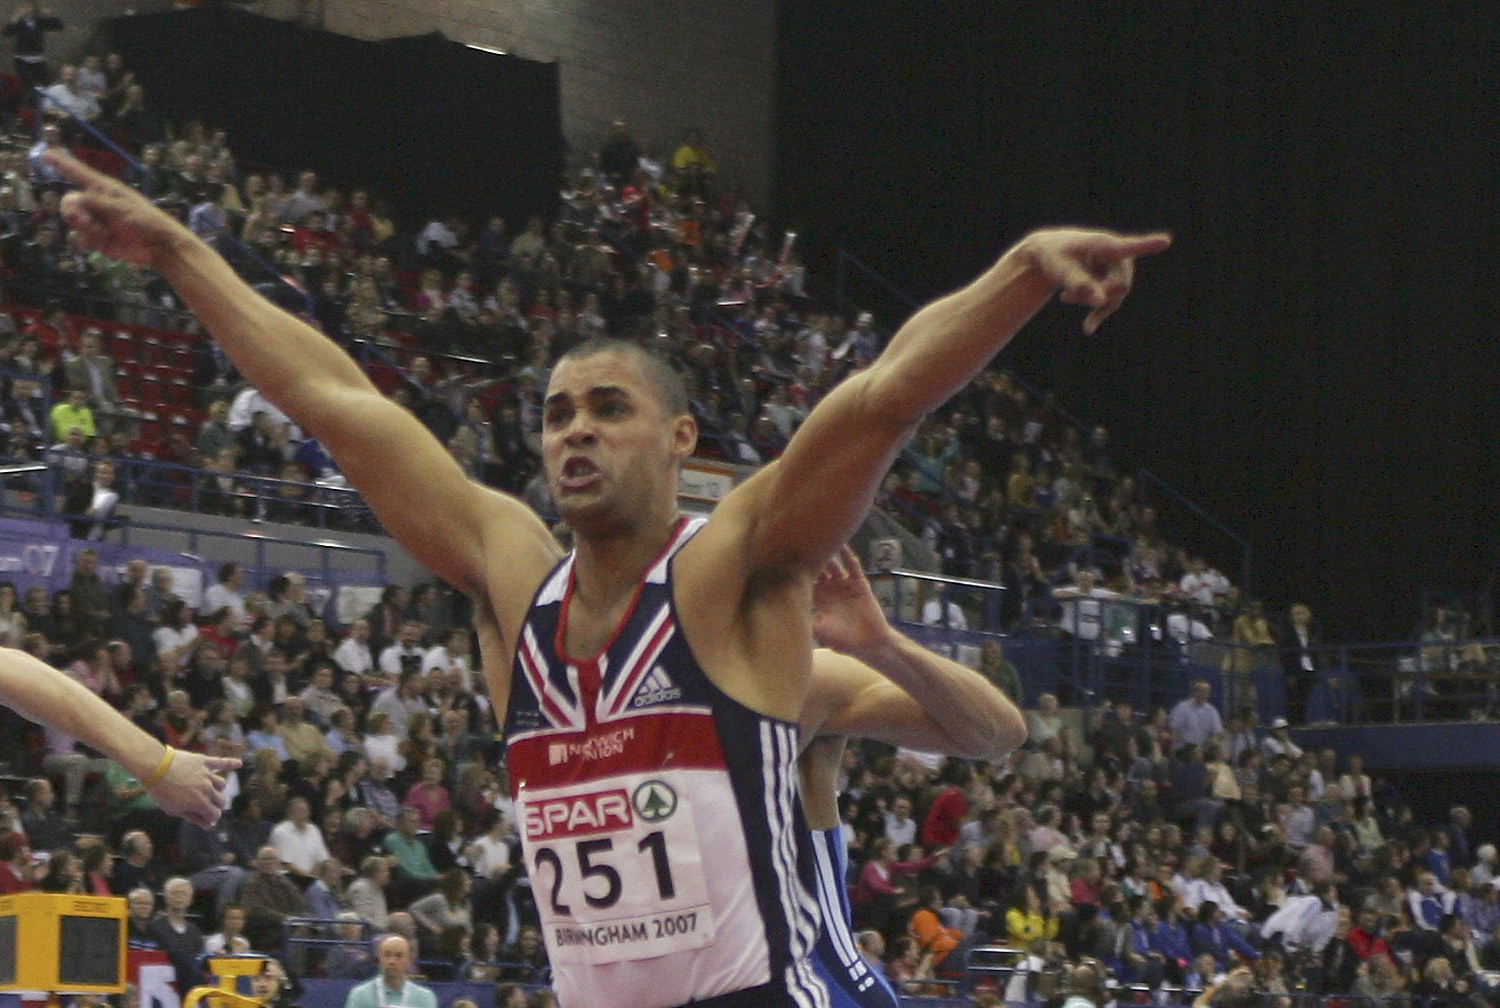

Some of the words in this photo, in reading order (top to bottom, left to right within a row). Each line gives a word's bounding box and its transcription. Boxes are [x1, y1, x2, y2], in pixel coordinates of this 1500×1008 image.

[633, 687, 683, 708] adidas
[582, 743, 624, 761] NION
[526, 795, 629, 837] SPAR
[534, 831, 676, 917] 251
[653, 912, 698, 940] 2007
